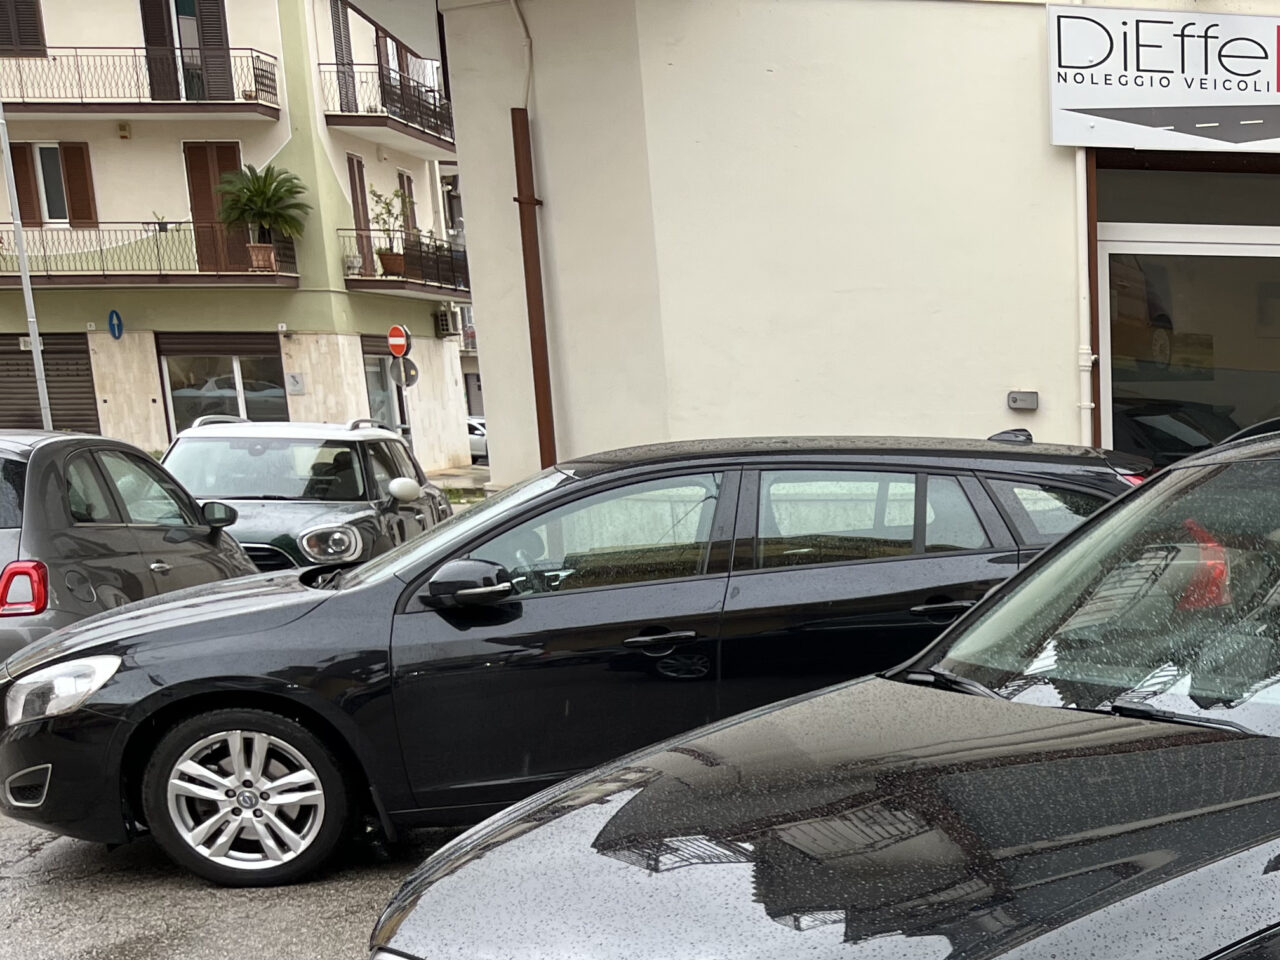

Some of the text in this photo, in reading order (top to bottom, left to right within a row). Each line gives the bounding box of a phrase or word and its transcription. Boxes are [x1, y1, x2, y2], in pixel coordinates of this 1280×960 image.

[1057, 15, 1268, 76] DiEffe
[1057, 72, 1270, 92] NOLEGGIO VEICOLI
